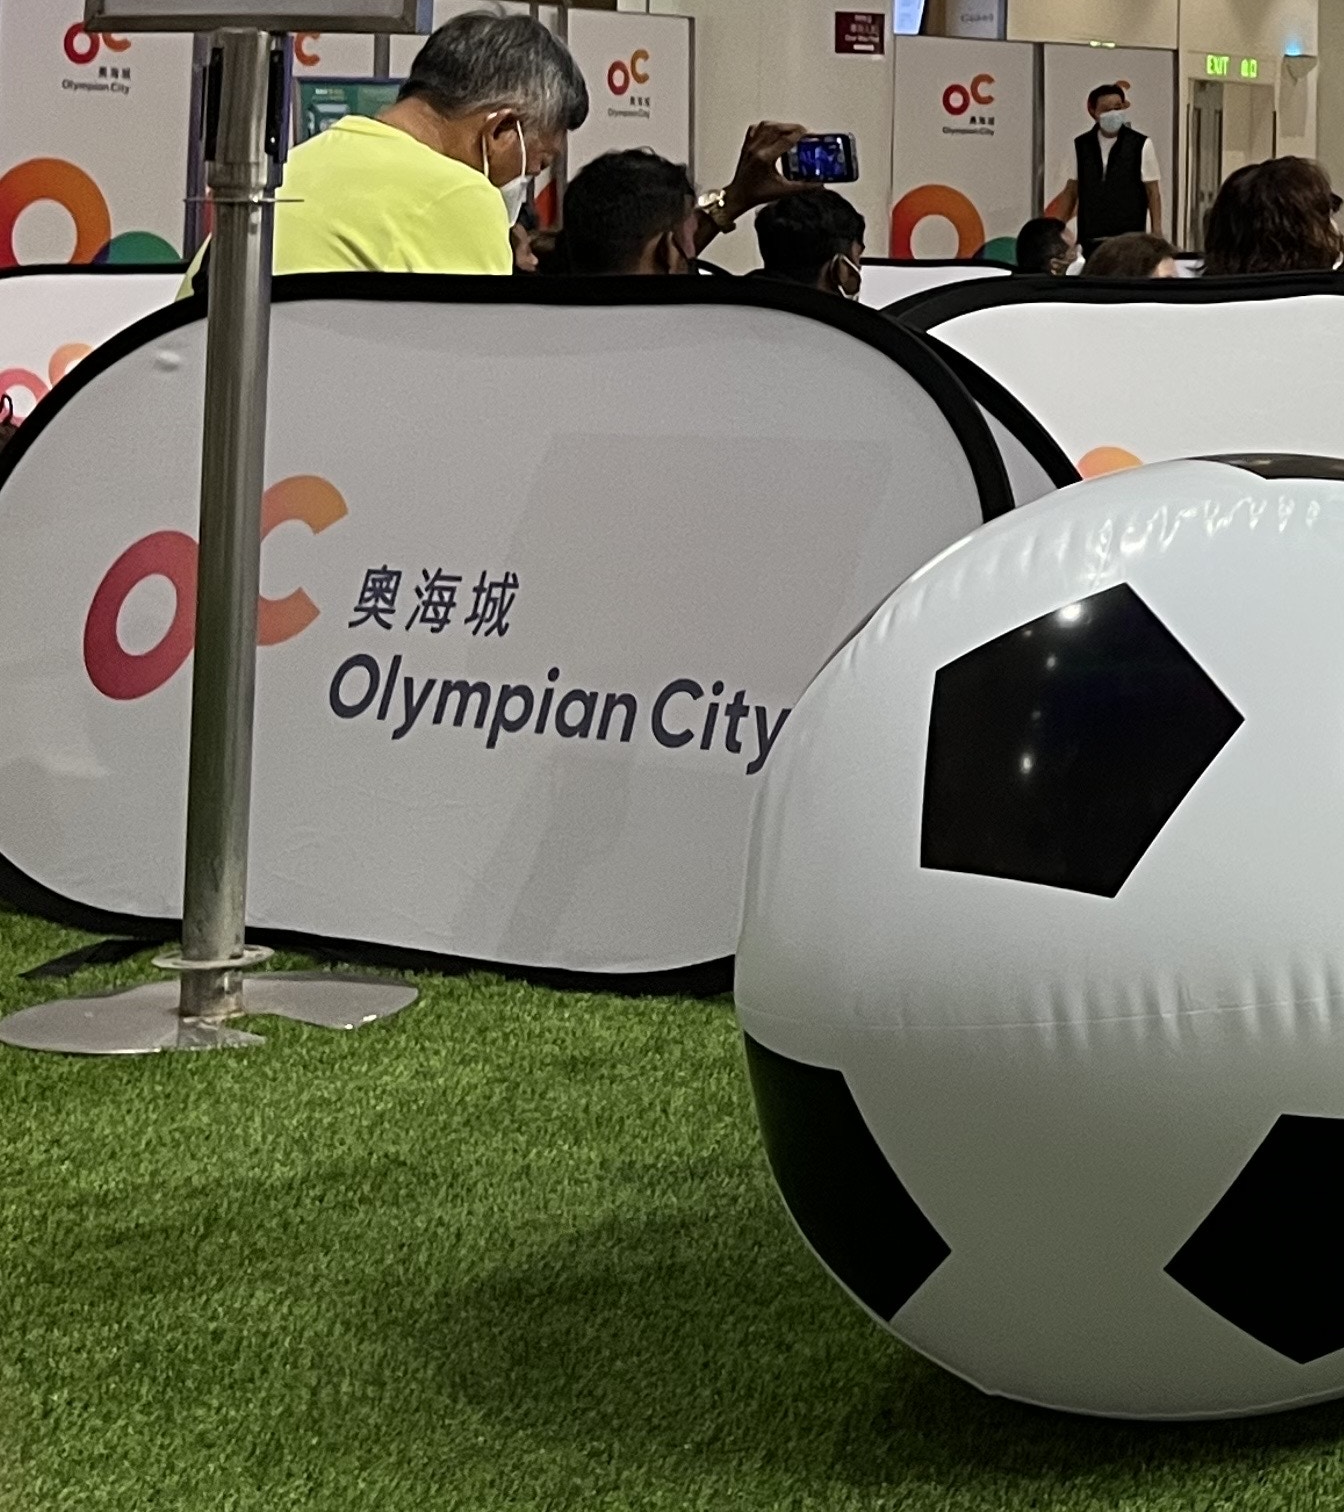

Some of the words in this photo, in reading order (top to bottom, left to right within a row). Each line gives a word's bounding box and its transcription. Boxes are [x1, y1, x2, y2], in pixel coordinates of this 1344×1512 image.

[607, 49, 650, 95] OC
[1206, 54, 1230, 76] EXIT
[942, 73, 995, 116] OC
[348, 563, 520, 638] 奧海城
[328, 653, 639, 749] Olympian
[650, 678, 796, 775] City
